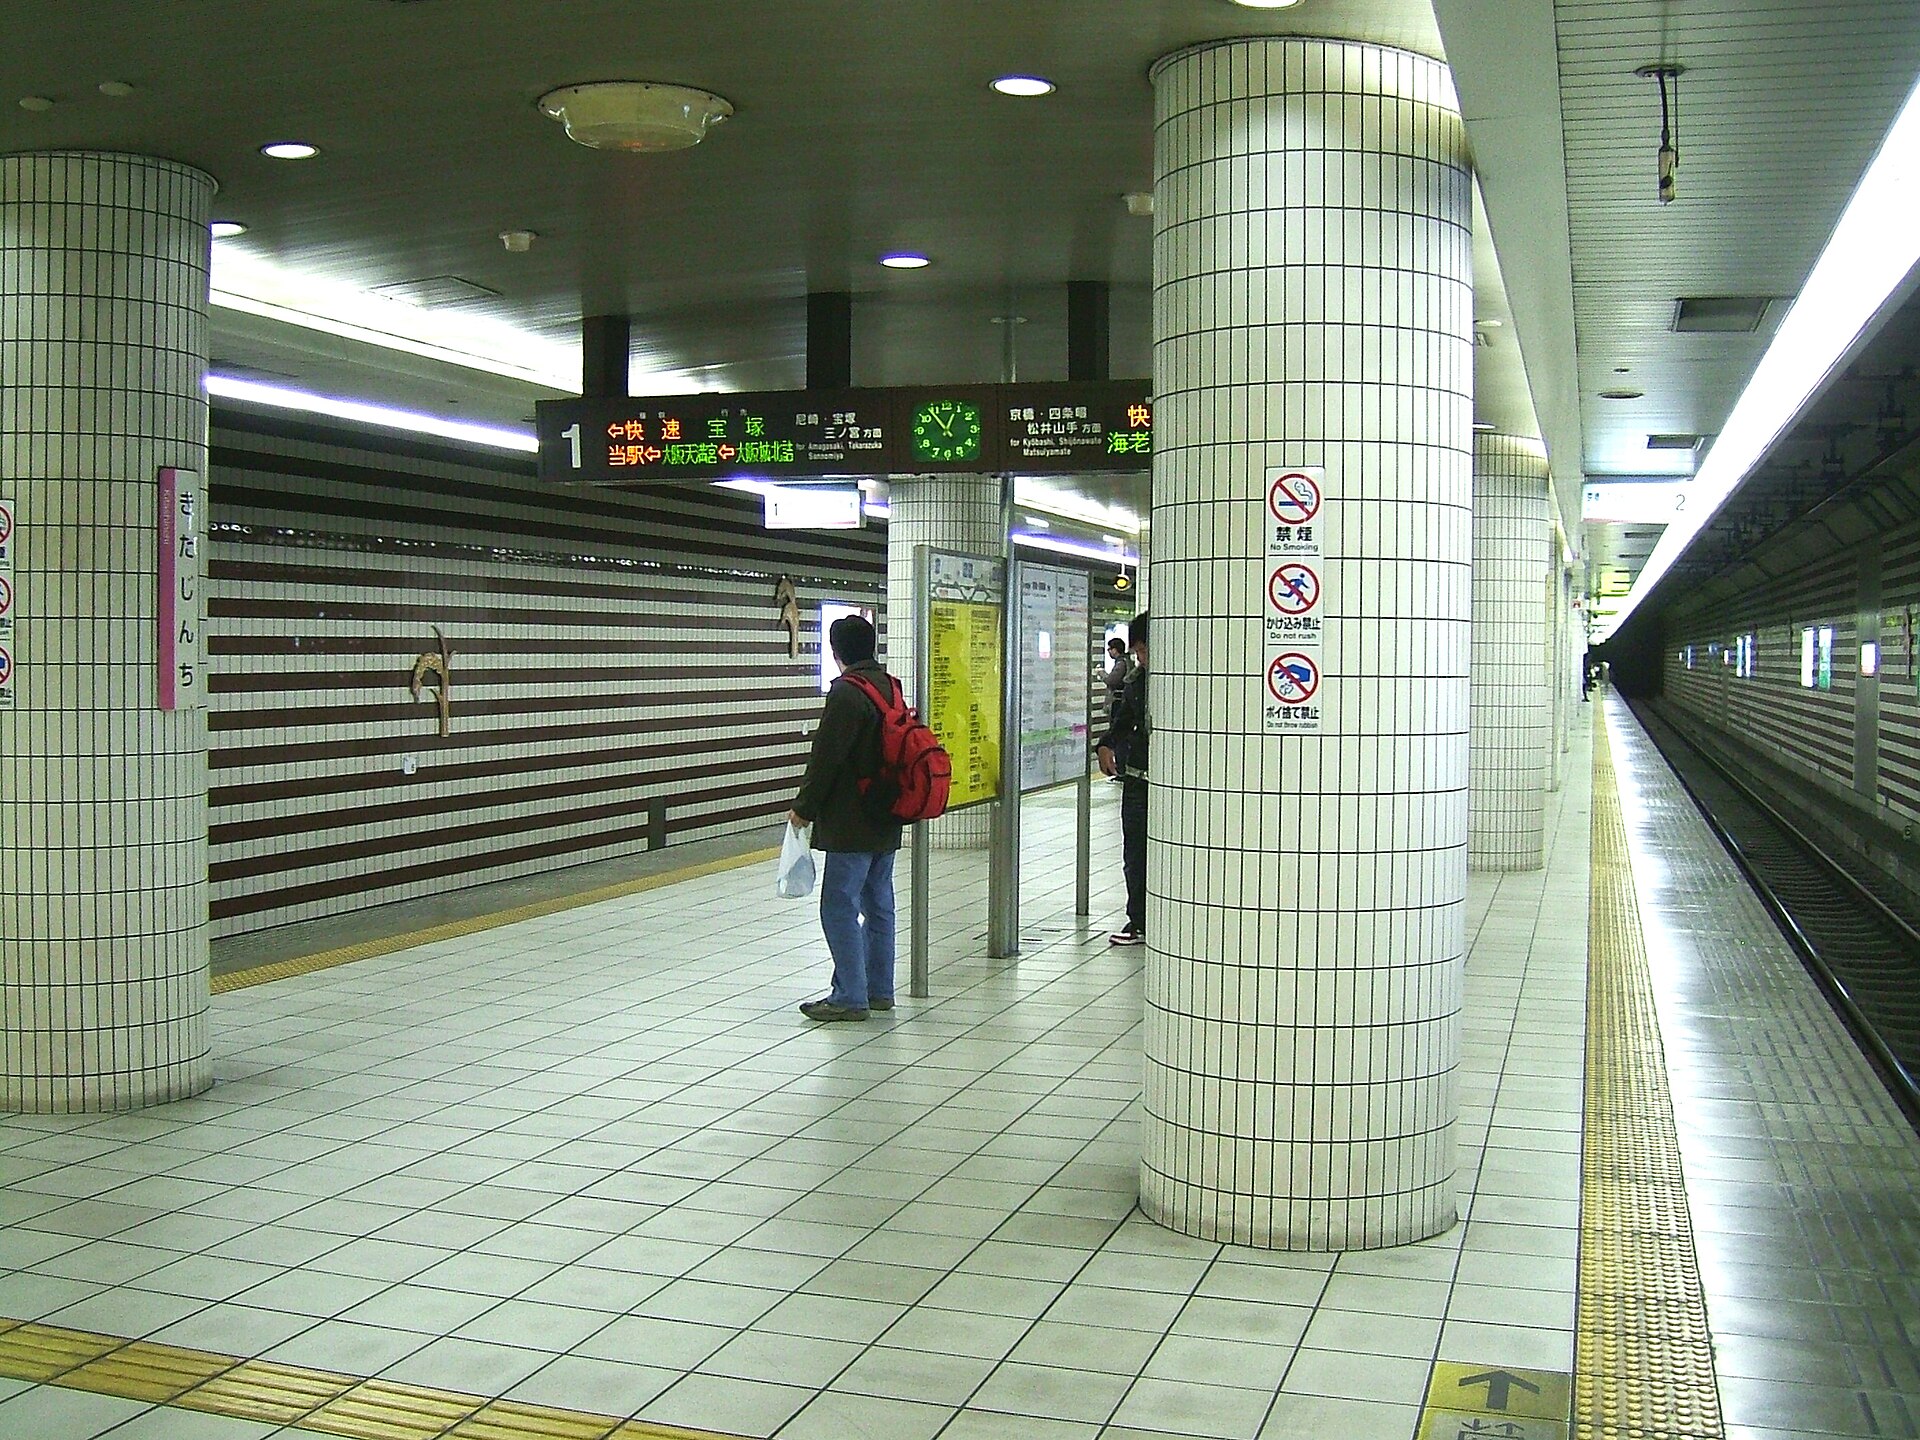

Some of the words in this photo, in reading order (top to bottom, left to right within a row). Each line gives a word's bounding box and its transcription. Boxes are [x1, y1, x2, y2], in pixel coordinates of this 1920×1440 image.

[941, 402, 953, 410] 12
[921, 414, 932, 423] 10
[964, 412, 973, 421] 2
[625, 419, 681, 441] 快速
[707, 417, 765, 438] 宝塚
[823, 426, 861, 439] 三ノ宮
[862, 428, 882, 438] 方面
[917, 426, 925, 435] 9
[969, 424, 978, 434] 3
[1027, 421, 1079, 435] 松井山手
[1081, 422, 1102, 434] 方面
[561, 423, 582, 469] 1
[922, 439, 931, 448] 8
[964, 438, 973, 447] 4
[1009, 438, 1020, 448] for
[608, 444, 645, 466] 当駅
[662, 442, 718, 465] 大阪天満宮
[932, 447, 941, 456] 7
[944, 450, 952, 458] 6
[955, 446, 964, 455] 5
[1675, 493, 1687, 511] 2
[1276, 526, 1313, 542] 禁煙
[1270, 543, 1281, 551] No
[1283, 543, 1319, 552] Smoking
[1266, 616, 1321, 630] かけ込み禁止
[1266, 720, 1274, 728] Do
